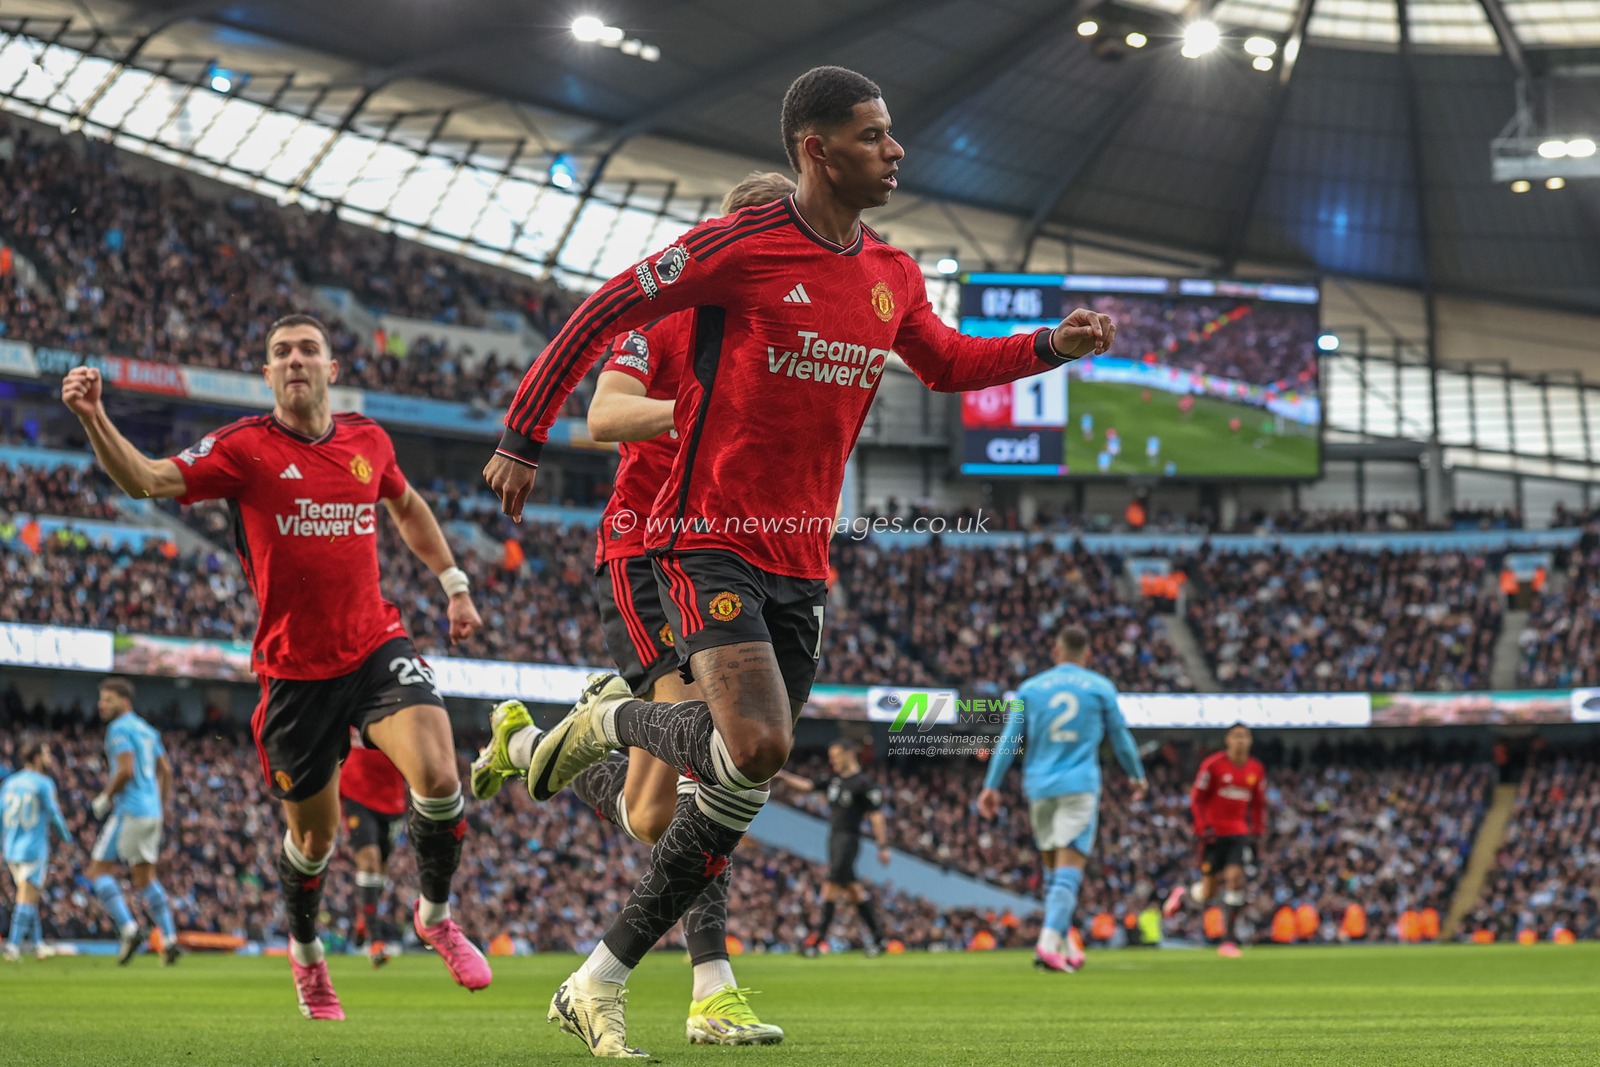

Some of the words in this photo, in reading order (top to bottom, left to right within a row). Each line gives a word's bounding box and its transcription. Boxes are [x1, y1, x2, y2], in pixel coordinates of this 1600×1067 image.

[768, 346, 862, 387] Viewer
[797, 331, 867, 365] Team
[1028, 380, 1043, 417] 1
[275, 514, 353, 536] Viewer
[294, 498, 354, 519] Team
[1050, 691, 1079, 742] 2
[3, 792, 39, 830] 20
